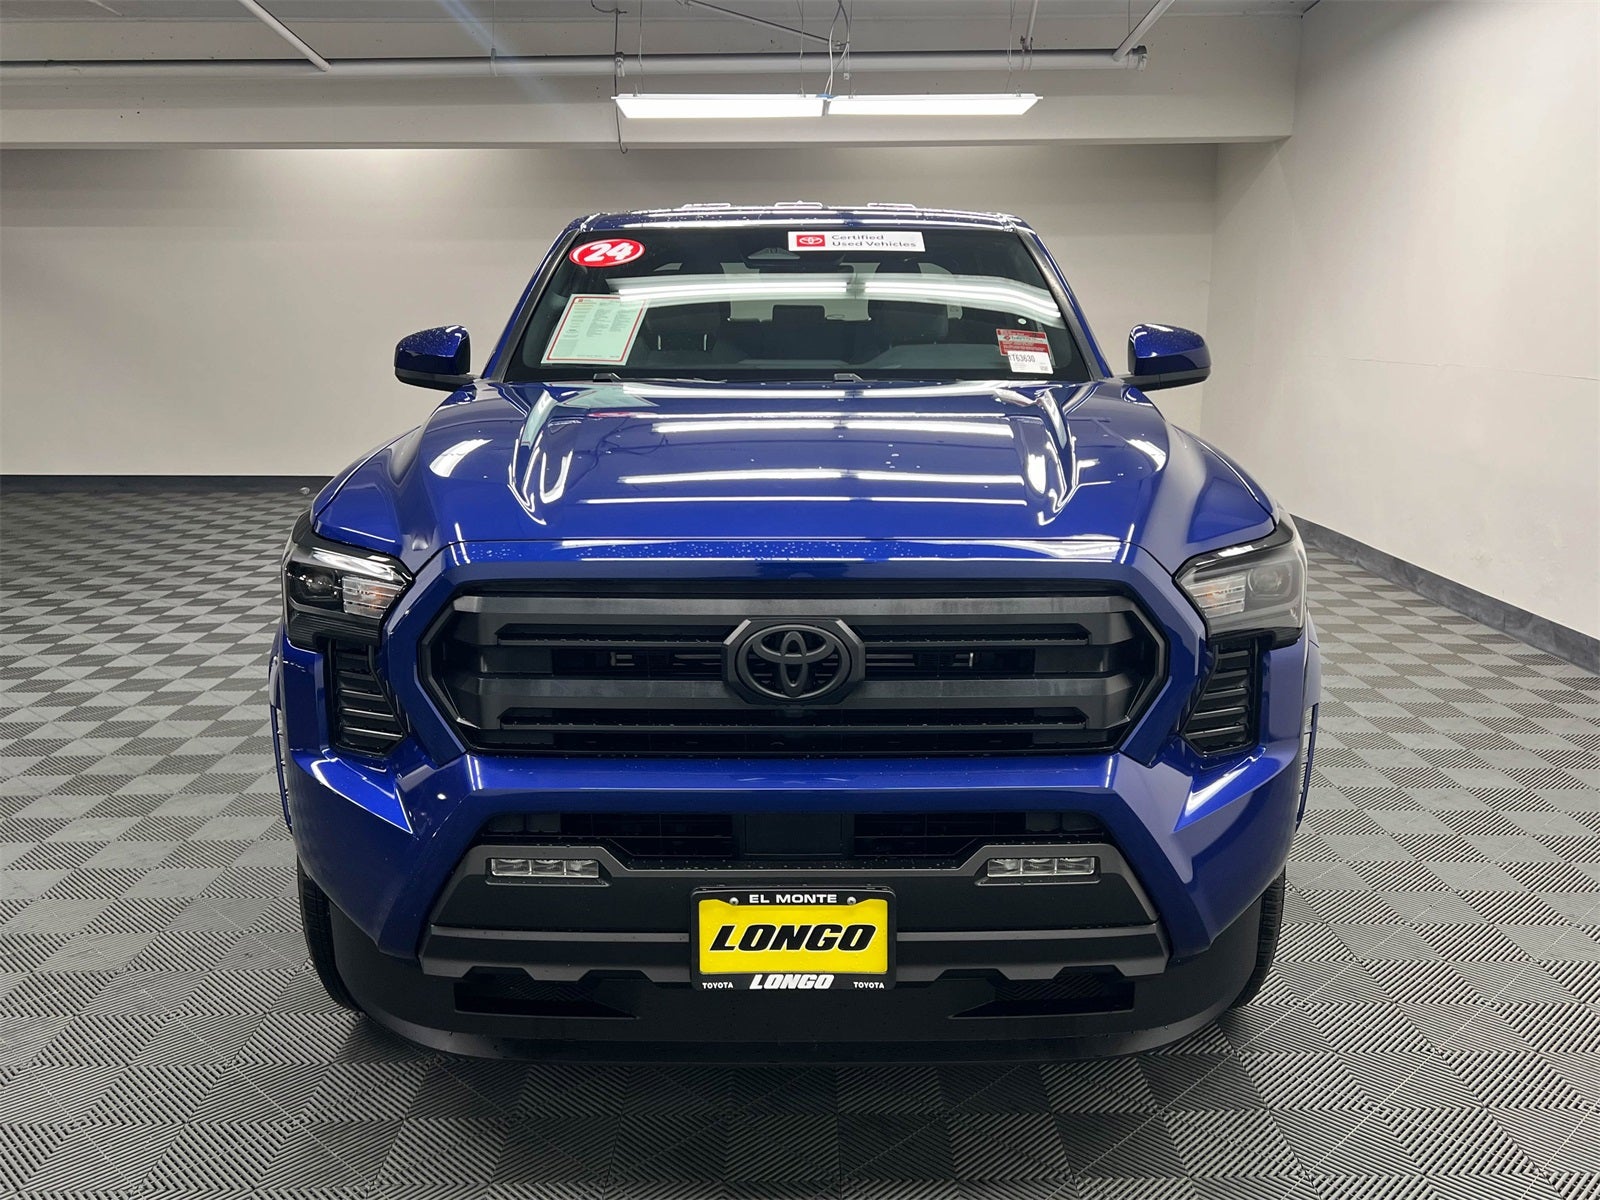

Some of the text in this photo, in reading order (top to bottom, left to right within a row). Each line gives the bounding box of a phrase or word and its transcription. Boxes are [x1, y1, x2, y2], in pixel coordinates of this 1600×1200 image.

[583, 242, 634, 262] 24
[749, 894, 837, 904] EL MONTE
[709, 924, 877, 952] LONGO
[702, 981, 734, 990] TOYOTA
[749, 974, 835, 990] LONGO
[853, 981, 885, 989] TOYOTA
